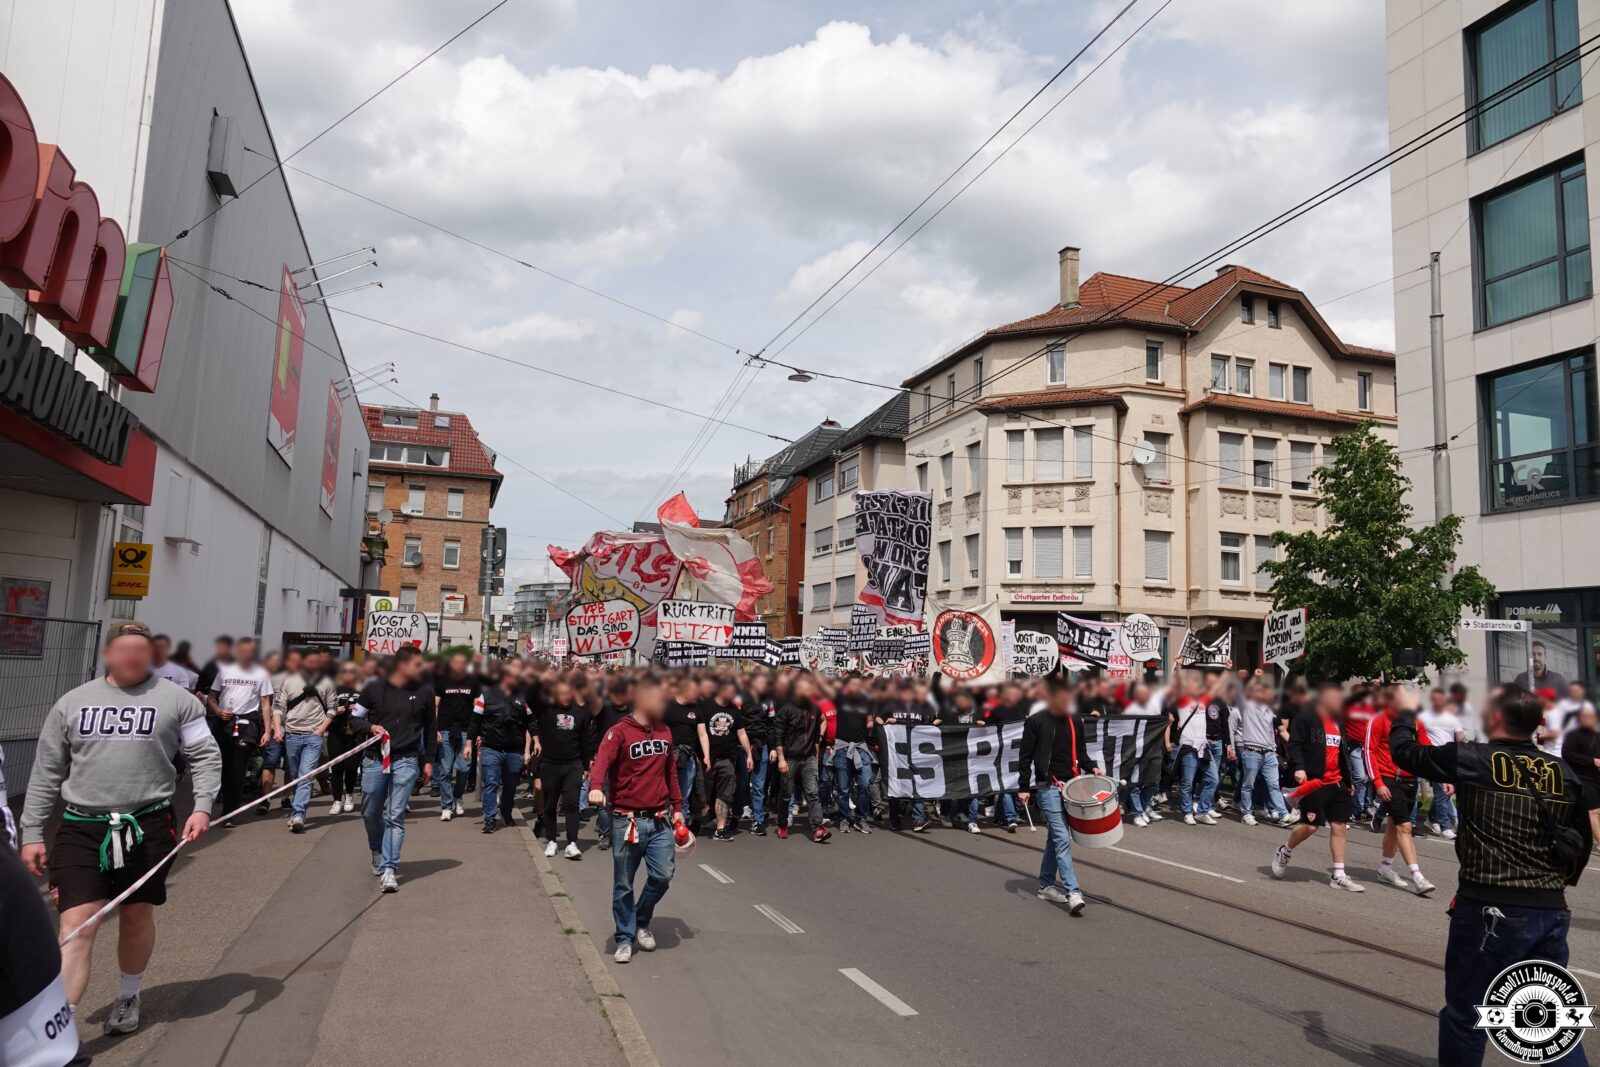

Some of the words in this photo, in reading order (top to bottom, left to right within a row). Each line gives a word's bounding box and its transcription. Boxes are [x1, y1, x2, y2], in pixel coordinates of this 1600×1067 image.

[0, 312, 139, 468] BAUMARKT
[1515, 490, 1561, 502] HYDRAULICS
[1014, 593, 1051, 601] Stuttgarter
[1508, 606, 1526, 616] JOB
[1528, 606, 1541, 615] AG
[372, 615, 405, 627] VOGT
[411, 614, 419, 629] &
[568, 610, 634, 626] STUTTGART
[852, 615, 877, 624] VOGT
[1267, 614, 1289, 633] VOGT
[1290, 611, 1302, 626] und
[577, 626, 599, 636] DAS
[602, 622, 628, 635] SIND
[852, 624, 876, 635] UND
[1472, 621, 1512, 630] Stadtarchiv
[659, 621, 734, 644] JETZT!
[733, 626, 766, 637] NNER
[732, 639, 766, 647] ALSCHE
[1015, 633, 1034, 643] VOGT
[1036, 636, 1051, 644] UND
[1083, 631, 1111, 650] IST
[1265, 628, 1292, 648] ADRION
[850, 641, 875, 650] RAUS
[1014, 645, 1038, 655] DRION
[716, 648, 766, 657] SCHLANGE
[872, 651, 903, 659] MAUL
[1264, 645, 1281, 661] ZEIT
[1013, 656, 1035, 664] ZEIT
[79, 706, 158, 736] UCSD
[630, 739, 670, 760] CC97
[885, 724, 947, 798] ES
